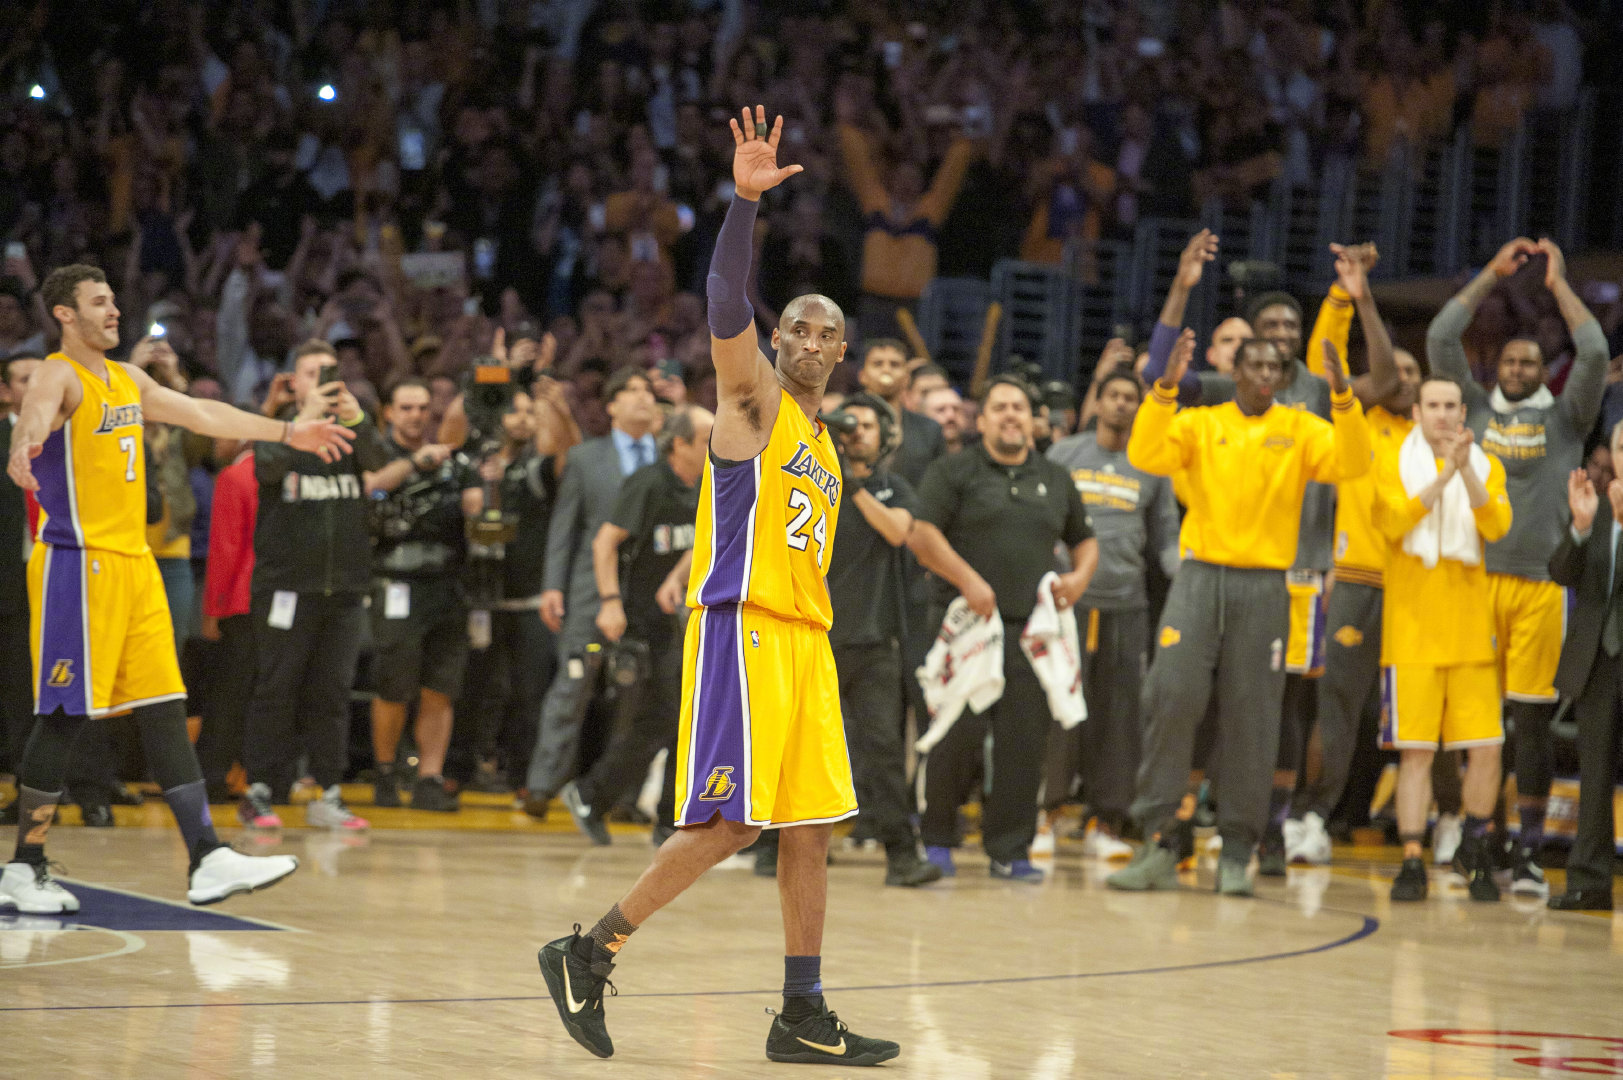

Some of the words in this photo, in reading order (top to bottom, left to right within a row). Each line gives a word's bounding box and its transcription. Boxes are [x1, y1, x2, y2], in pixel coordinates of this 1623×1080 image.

[119, 435, 136, 482] 7
[780, 440, 840, 508] LAKERS
[786, 487, 826, 569] 24
